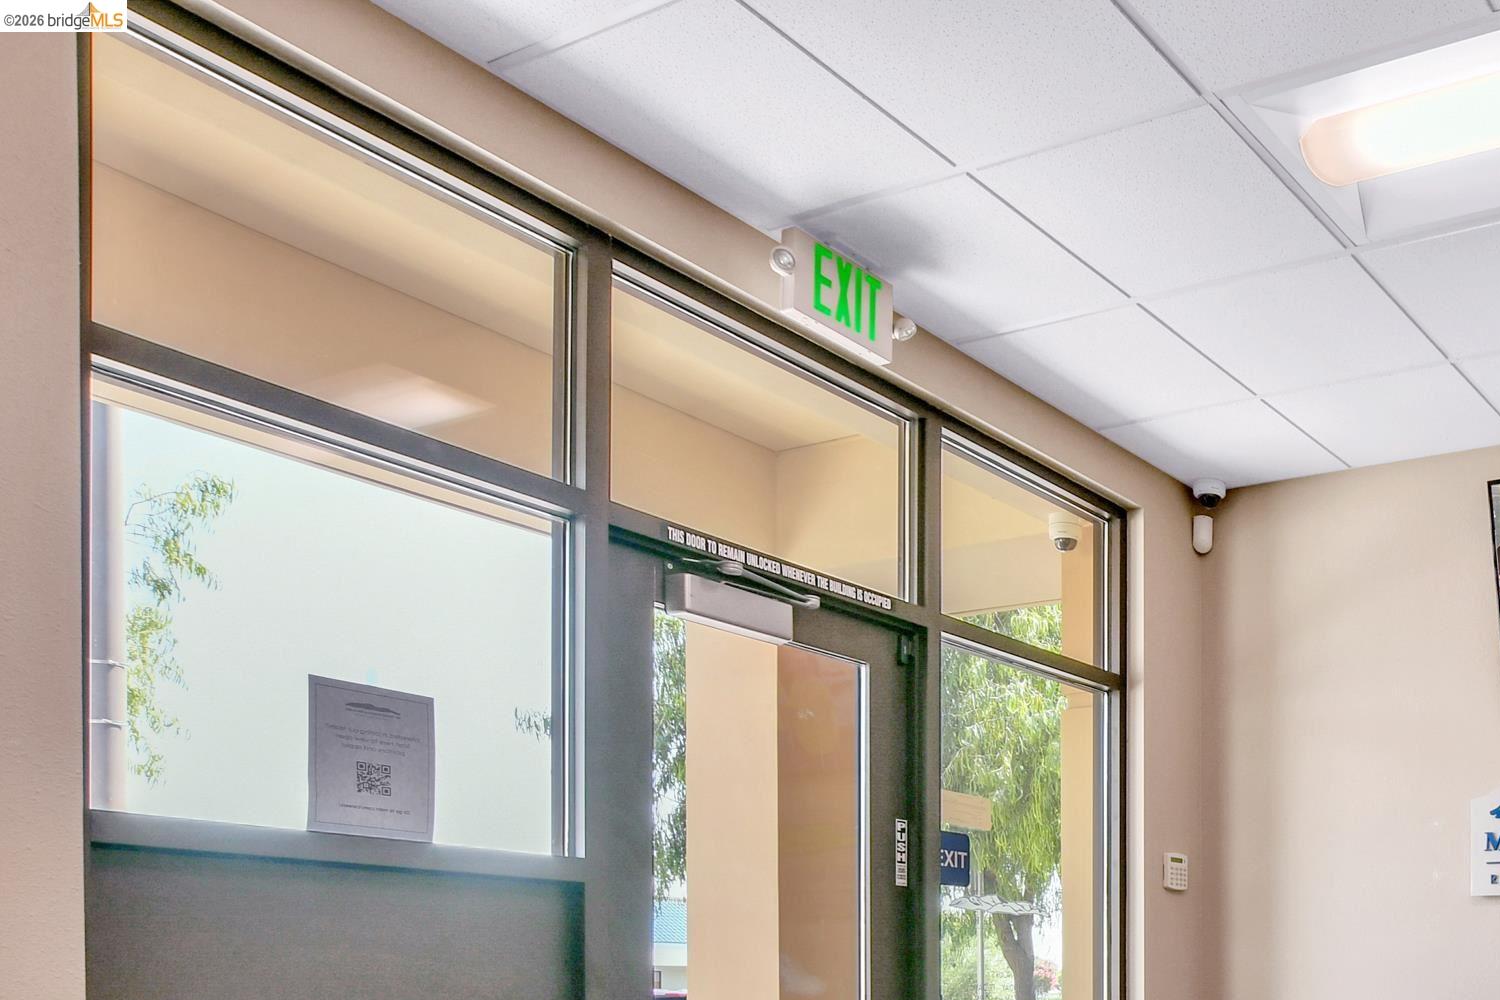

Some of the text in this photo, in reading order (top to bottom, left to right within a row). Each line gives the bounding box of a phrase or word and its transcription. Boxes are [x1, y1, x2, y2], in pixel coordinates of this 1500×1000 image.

[813, 242, 883, 342] EXIT
[667, 526, 892, 610] THIS DOOR TO REMAIN UNLOCKED WHENEVER THE BUILDING IS OCCUPIED
[897, 820, 906, 864] PUSH
